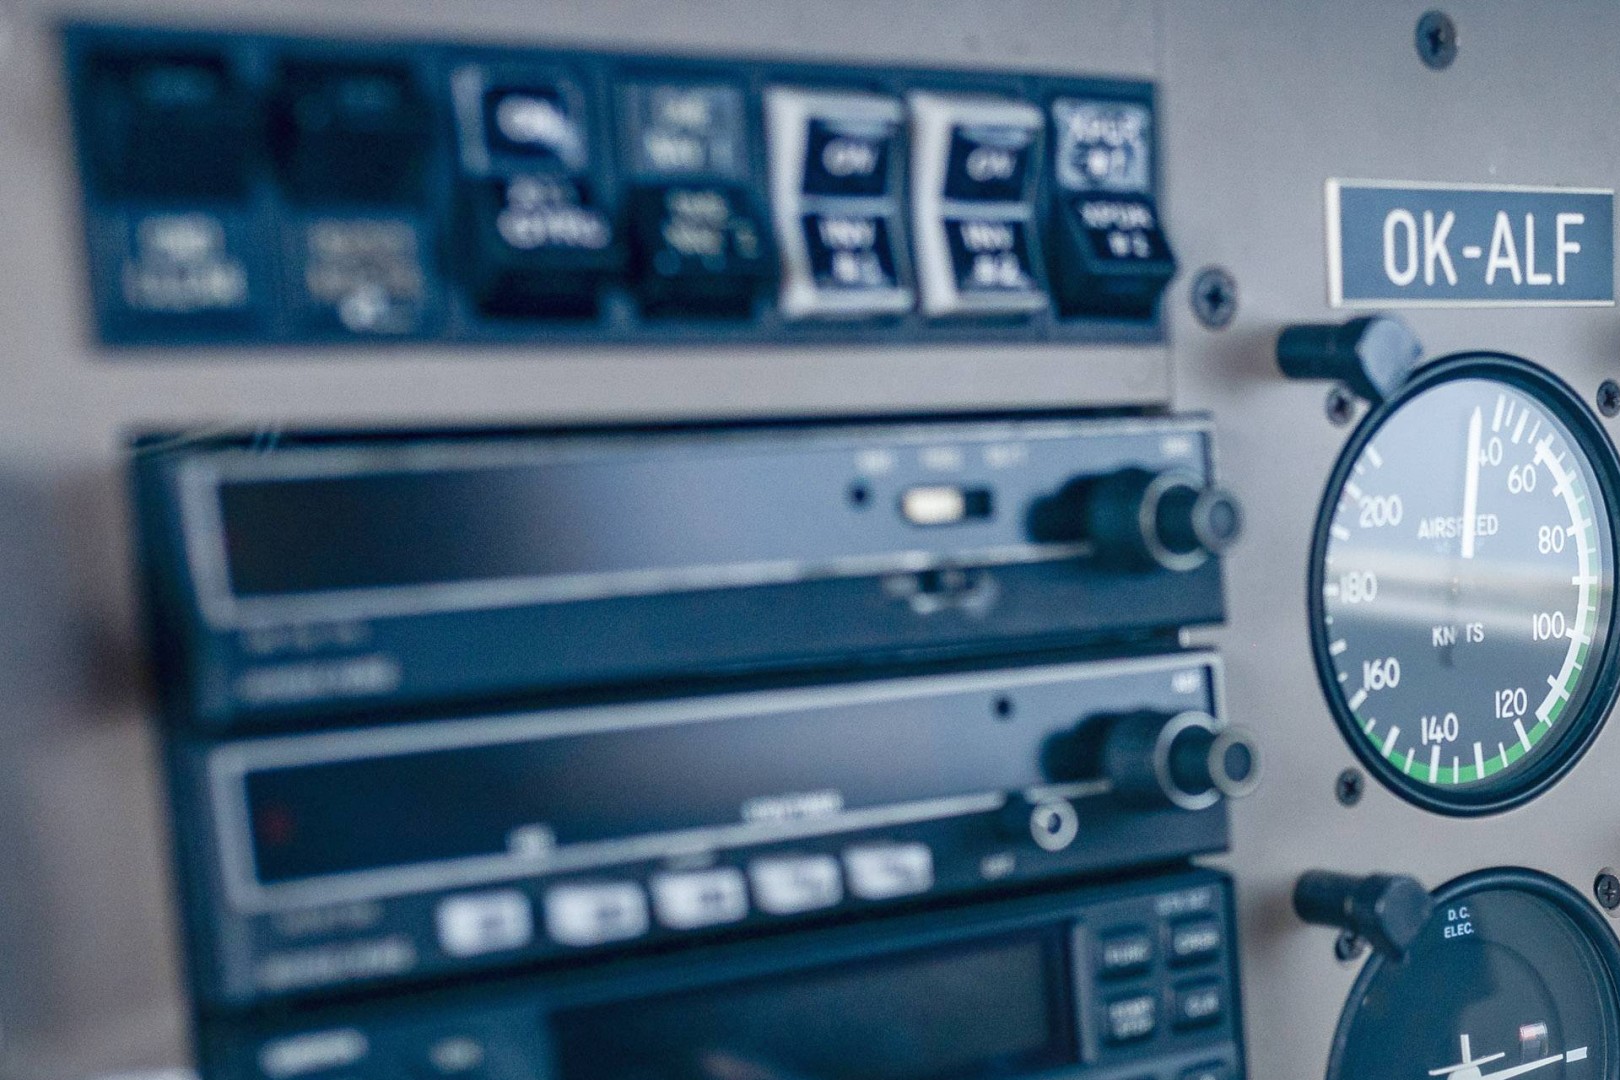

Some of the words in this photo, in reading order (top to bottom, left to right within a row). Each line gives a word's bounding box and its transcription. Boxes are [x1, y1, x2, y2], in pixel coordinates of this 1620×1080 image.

[1383, 208, 1585, 287] OK-ALF
[1507, 464, 1536, 494] 60
[1359, 494, 1403, 529] 200
[1417, 514, 1499, 540] AIRSED
[1538, 525, 1565, 554] 80
[1340, 570, 1378, 603] 180
[1431, 621, 1485, 648] KNTS
[1532, 611, 1565, 641] 100
[1362, 657, 1401, 691] 160
[1495, 688, 1528, 718] 120
[1421, 712, 1459, 745] 140
[1444, 922, 1475, 939] ELEC.
